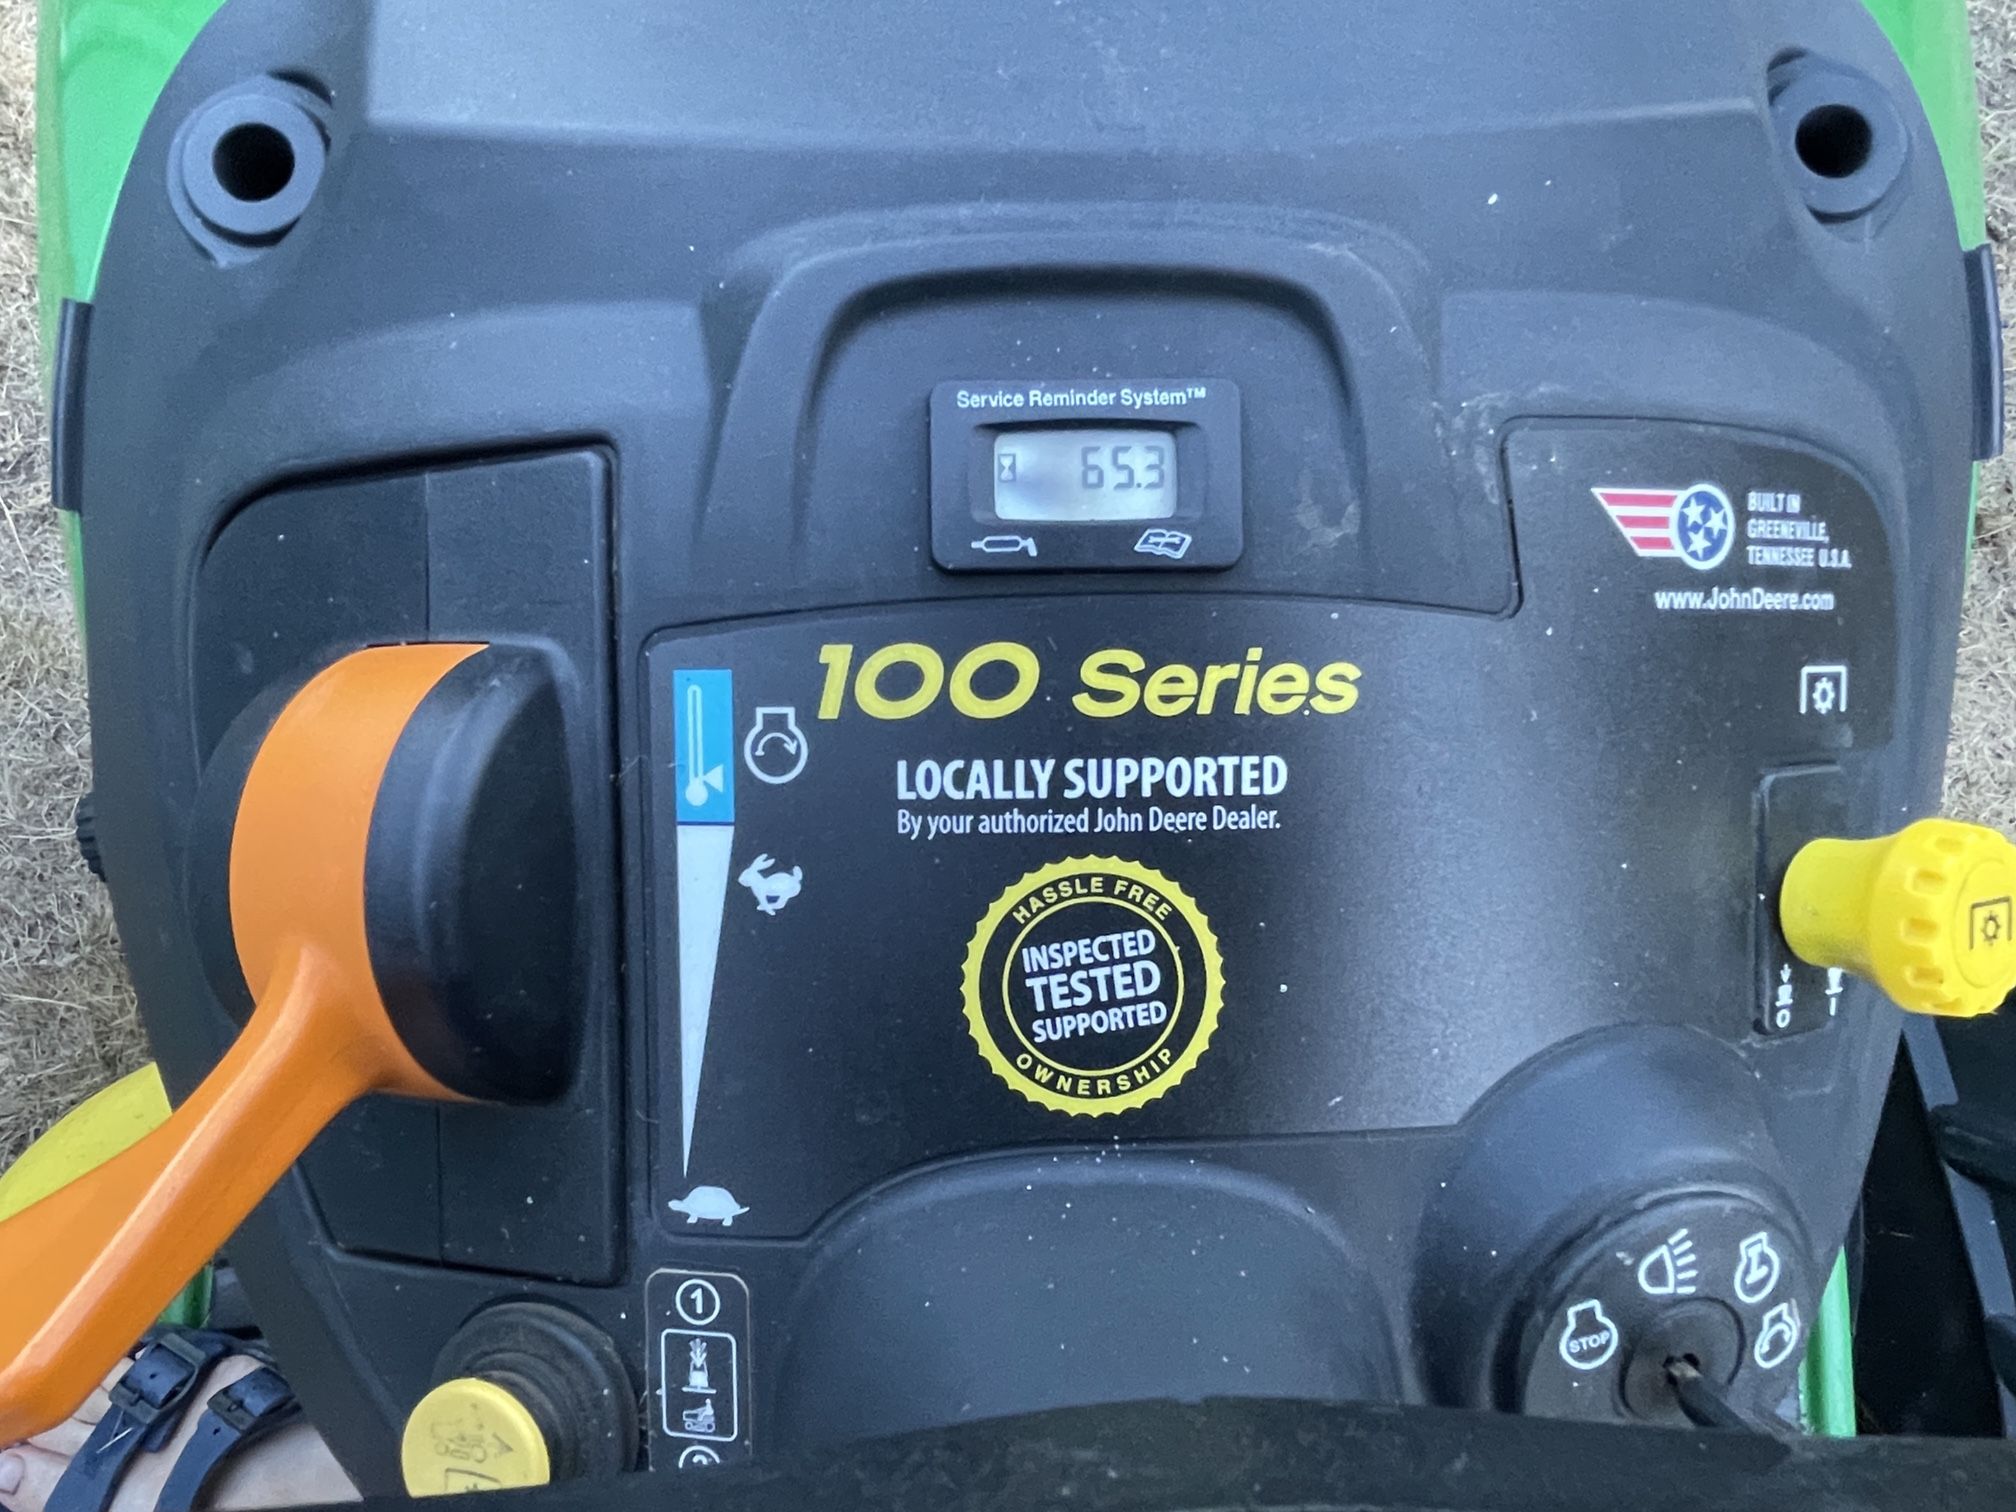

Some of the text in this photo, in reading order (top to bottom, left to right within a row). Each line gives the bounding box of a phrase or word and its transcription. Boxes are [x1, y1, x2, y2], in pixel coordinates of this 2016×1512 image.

[957, 391, 1024, 409] Service
[1030, 390, 1116, 408] Reminder
[1081, 446, 1165, 490] 65.3
[1747, 491, 1800, 513] BUILT IN
[1747, 519, 1829, 543] GREENEVILLE,
[1747, 545, 1852, 568] TENNESSEE U.S.A.
[1654, 587, 1834, 610] www.JohnDeere.com
[817, 642, 1362, 720] 100 Series
[896, 755, 1288, 800] LOCALLY SUPPORTED
[897, 804, 1281, 839] By your authorized John Deere Dealer.
[1012, 876, 1173, 924] HASSLE FREE
[1022, 928, 1156, 973] INSPECTED
[1025, 960, 1162, 1013] TESTED
[1032, 1000, 1168, 1043] SUPPORTED
[1016, 1047, 1173, 1096] OWNERSHIP
[690, 1288, 702, 1314] 1
[1568, 1330, 1610, 1353] STOP
